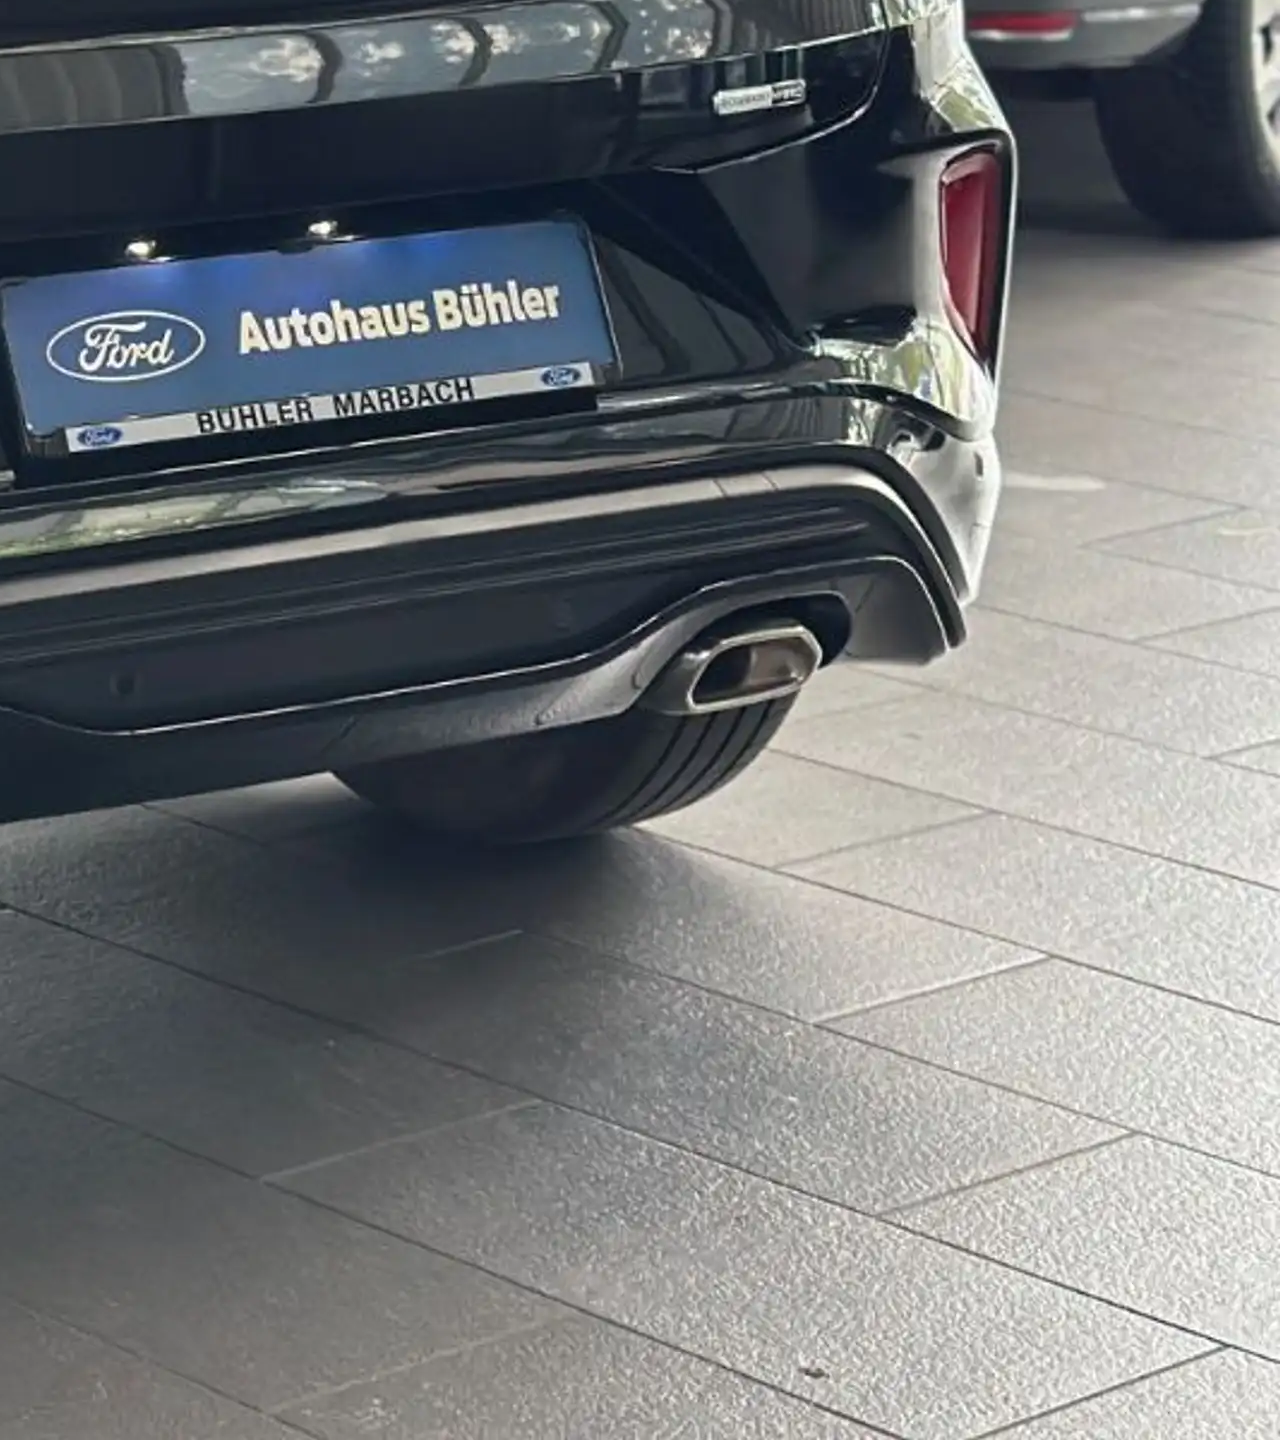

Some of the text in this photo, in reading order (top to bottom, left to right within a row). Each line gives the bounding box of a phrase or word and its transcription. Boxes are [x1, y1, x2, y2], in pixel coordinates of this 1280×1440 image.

[239, 279, 559, 354] Autohaus Bühler
[78, 321, 175, 372] Ford
[333, 377, 476, 417] MARBACH
